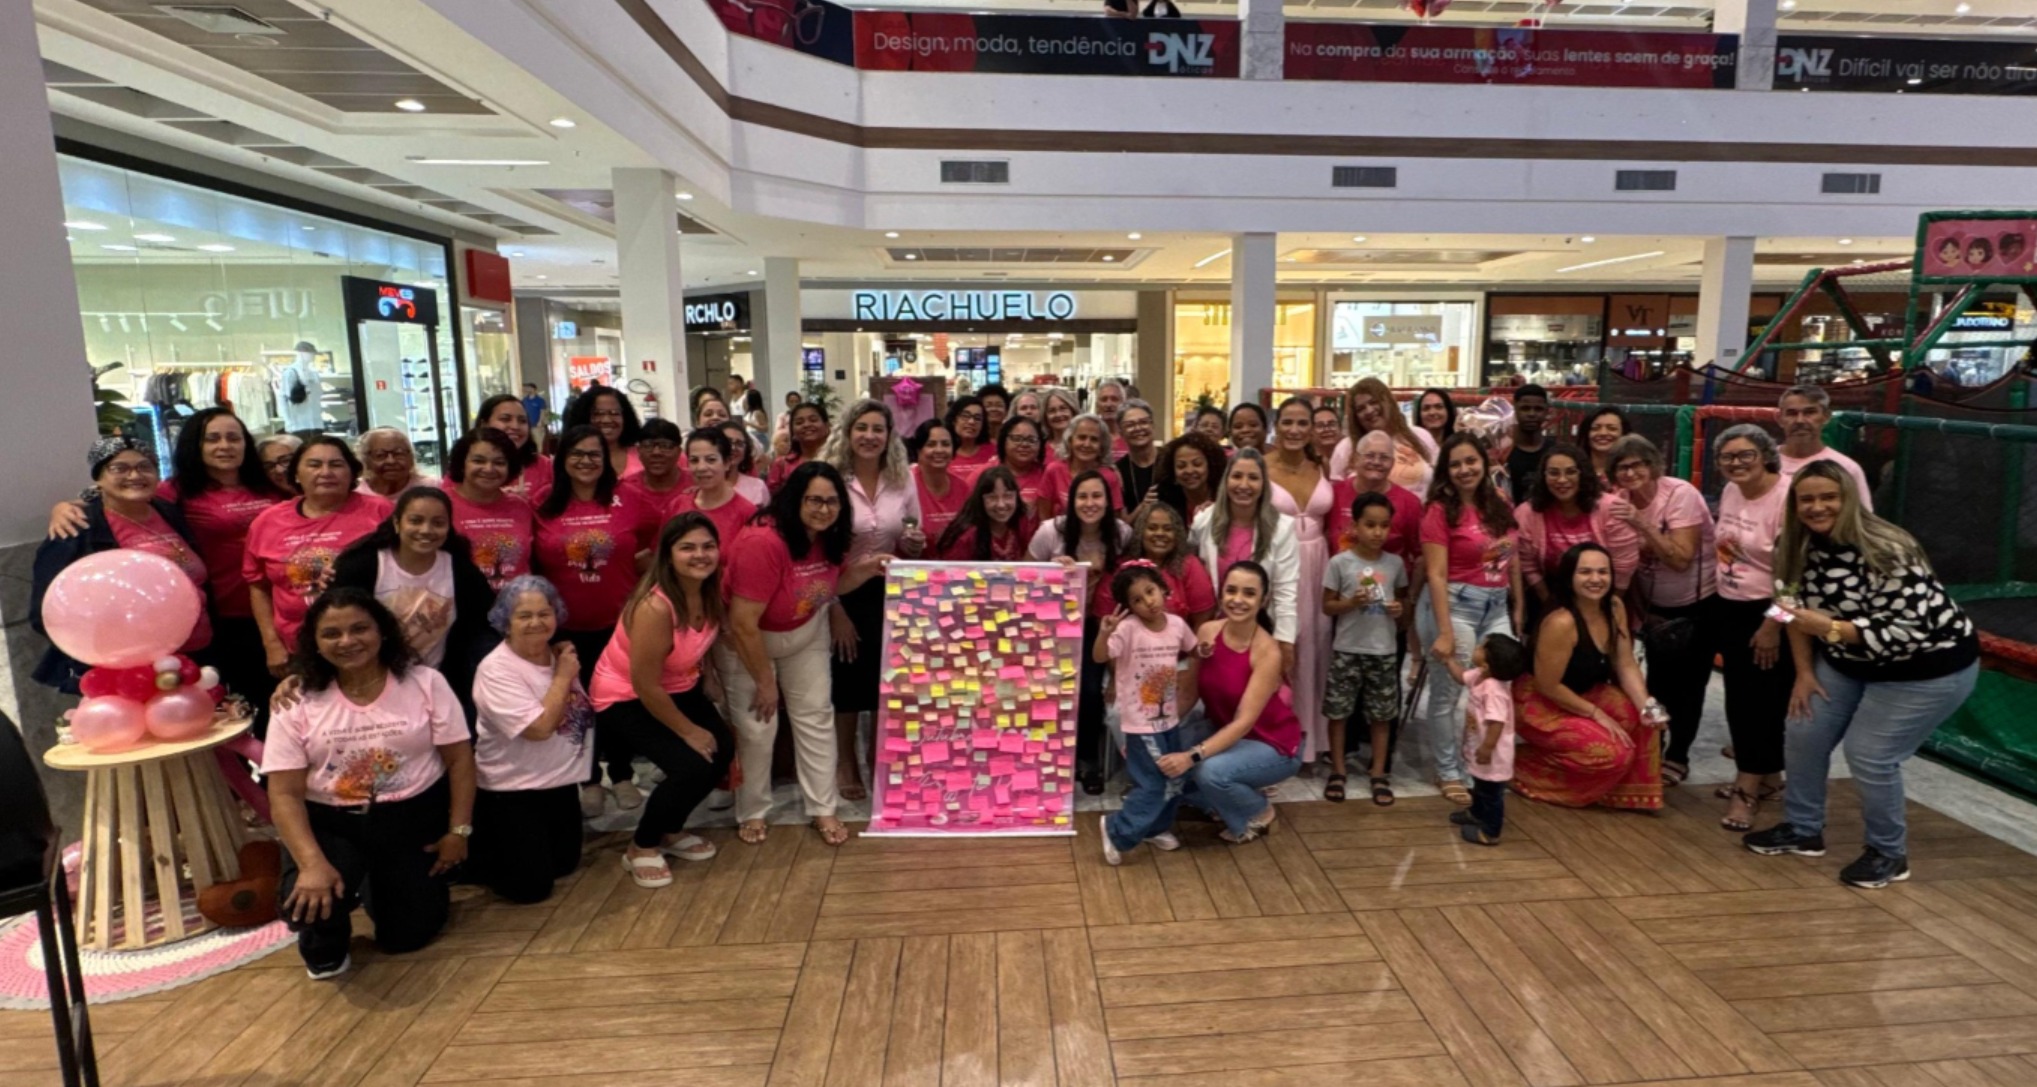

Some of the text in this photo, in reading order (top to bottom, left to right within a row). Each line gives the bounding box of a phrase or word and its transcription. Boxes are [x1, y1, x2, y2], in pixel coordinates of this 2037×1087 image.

[874, 32, 1136, 57] Design, moda, tendência
[1147, 32, 1215, 73] DNZ
[1290, 42, 1312, 56] Na
[1316, 44, 1381, 61] compra
[1385, 44, 1406, 58] da
[1410, 47, 1439, 59] sua
[1525, 48, 1560, 62] suas
[1563, 48, 1610, 63] lentes
[1615, 51, 1658, 64] saem
[1661, 50, 1680, 64] de
[1683, 51, 1735, 69] graça!
[1777, 47, 1834, 82] DNZ
[1838, 57, 1891, 77] Difícil
[1896, 59, 1925, 78] vai
[1929, 64, 1958, 79] ser
[1963, 61, 2001, 80] não
[685, 301, 735, 324] RCHLO
[854, 293, 1075, 320] RIACHUELO
[569, 361, 611, 378] SALDOS
